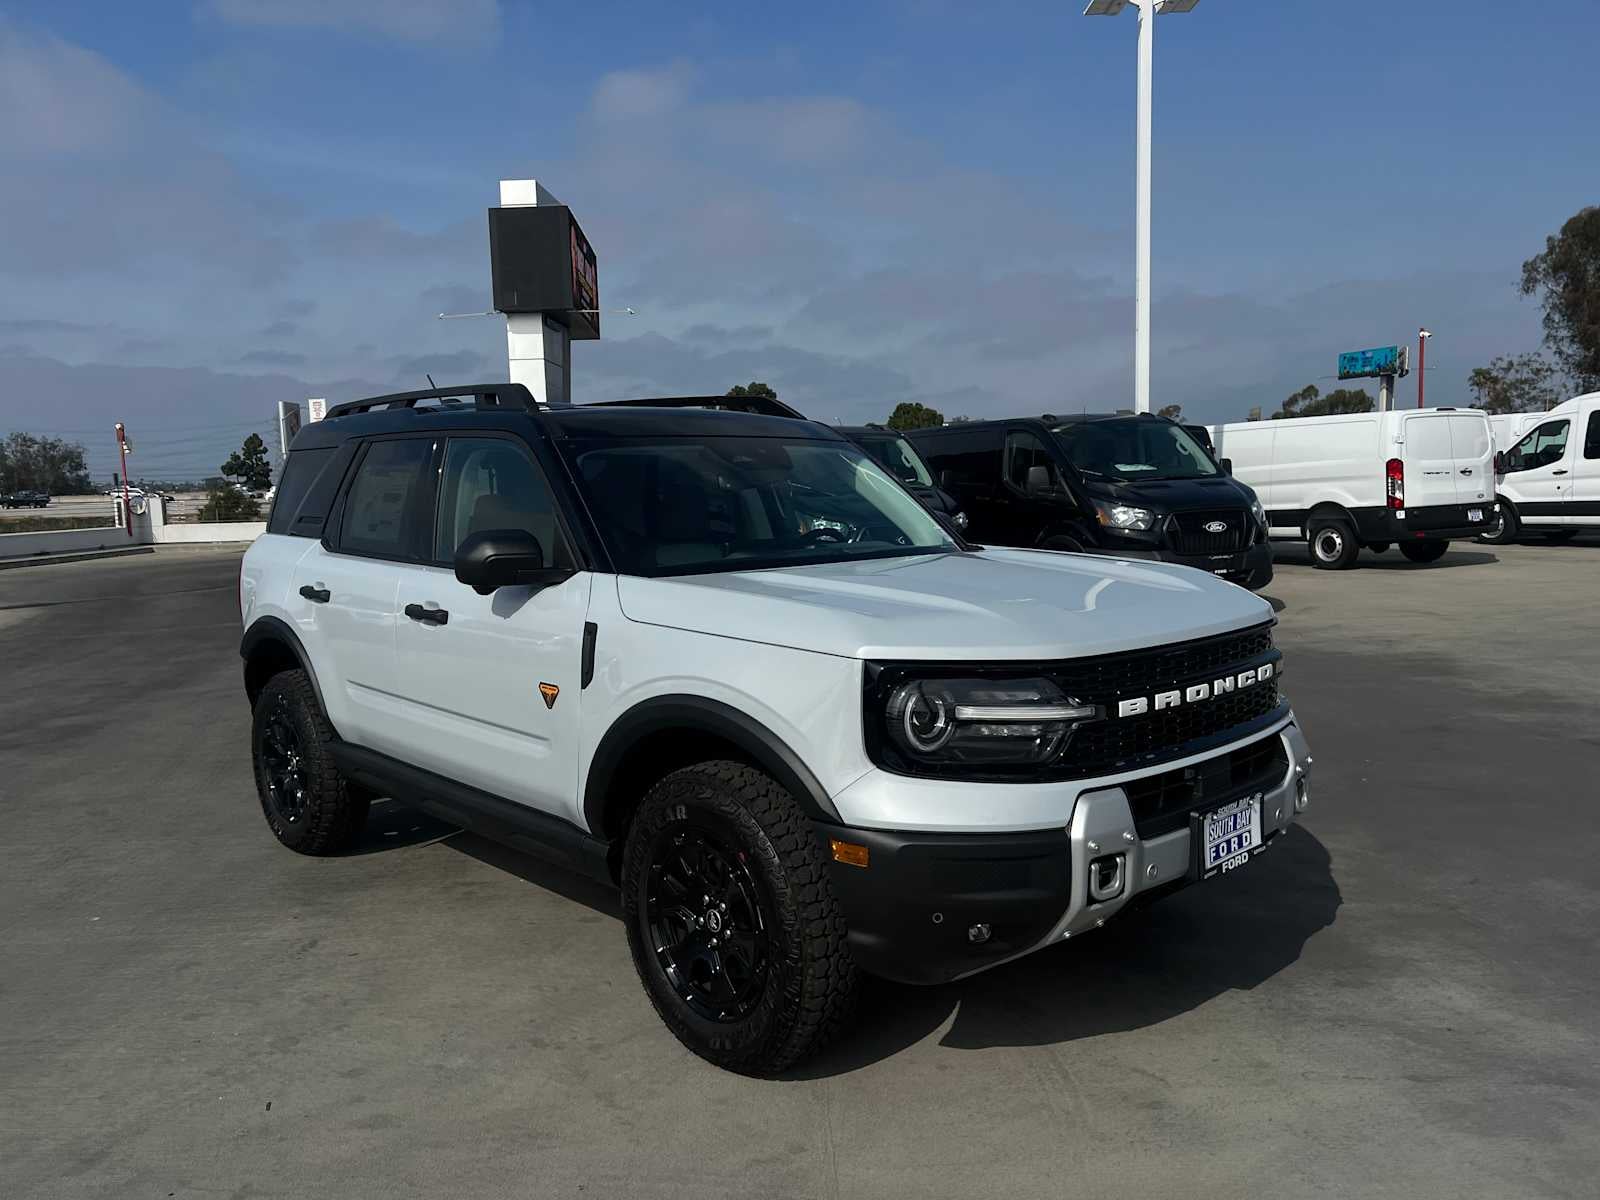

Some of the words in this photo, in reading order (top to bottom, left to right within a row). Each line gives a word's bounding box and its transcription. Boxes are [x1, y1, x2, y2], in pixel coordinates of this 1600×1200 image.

[1118, 663, 1273, 717] BRONCO
[1209, 815, 1234, 841] SOUTH
[1236, 808, 1251, 829] BAY
[1210, 831, 1251, 862] FORD
[1222, 852, 1249, 873] FORD
